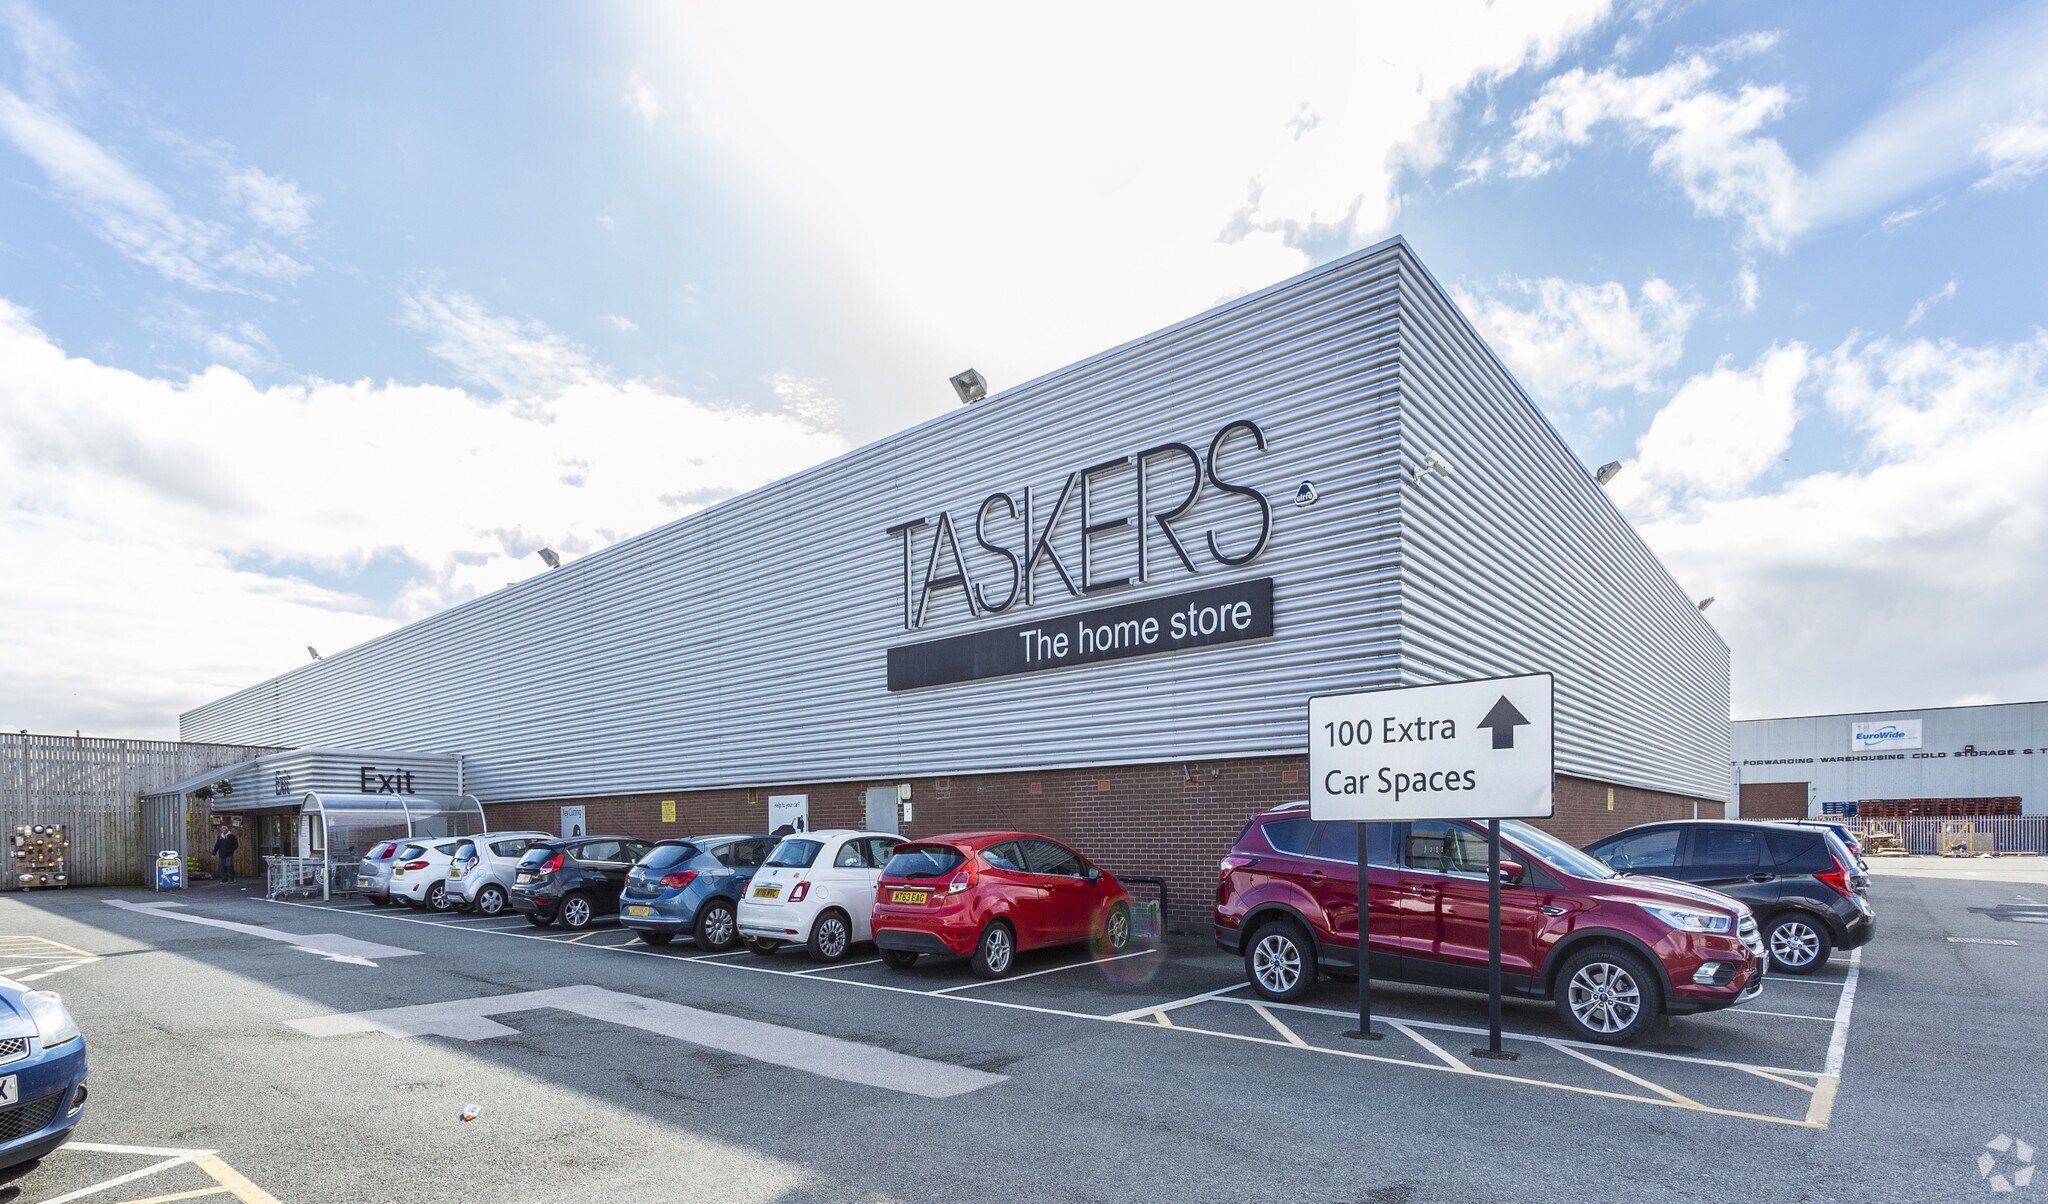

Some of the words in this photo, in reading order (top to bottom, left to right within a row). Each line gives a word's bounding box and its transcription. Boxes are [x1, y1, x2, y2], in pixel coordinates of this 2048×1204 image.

[886, 419, 1273, 630] TASKERS
[1019, 628, 1069, 662] The
[1079, 621, 1159, 654] home
[1170, 601, 1252, 640] store
[1324, 719, 1372, 747] 100
[1383, 716, 1456, 744] Extra
[1855, 731, 1905, 740] EuroWide
[1743, 757, 1814, 766] FORWARDING
[1820, 754, 1905, 763] WAREHOUSING
[1954, 749, 2015, 757] STORAGE
[360, 766, 415, 794] Exit
[1324, 769, 1369, 796] Car
[1377, 766, 1476, 802] Spaces
[911, 893, 925, 903] EAG
